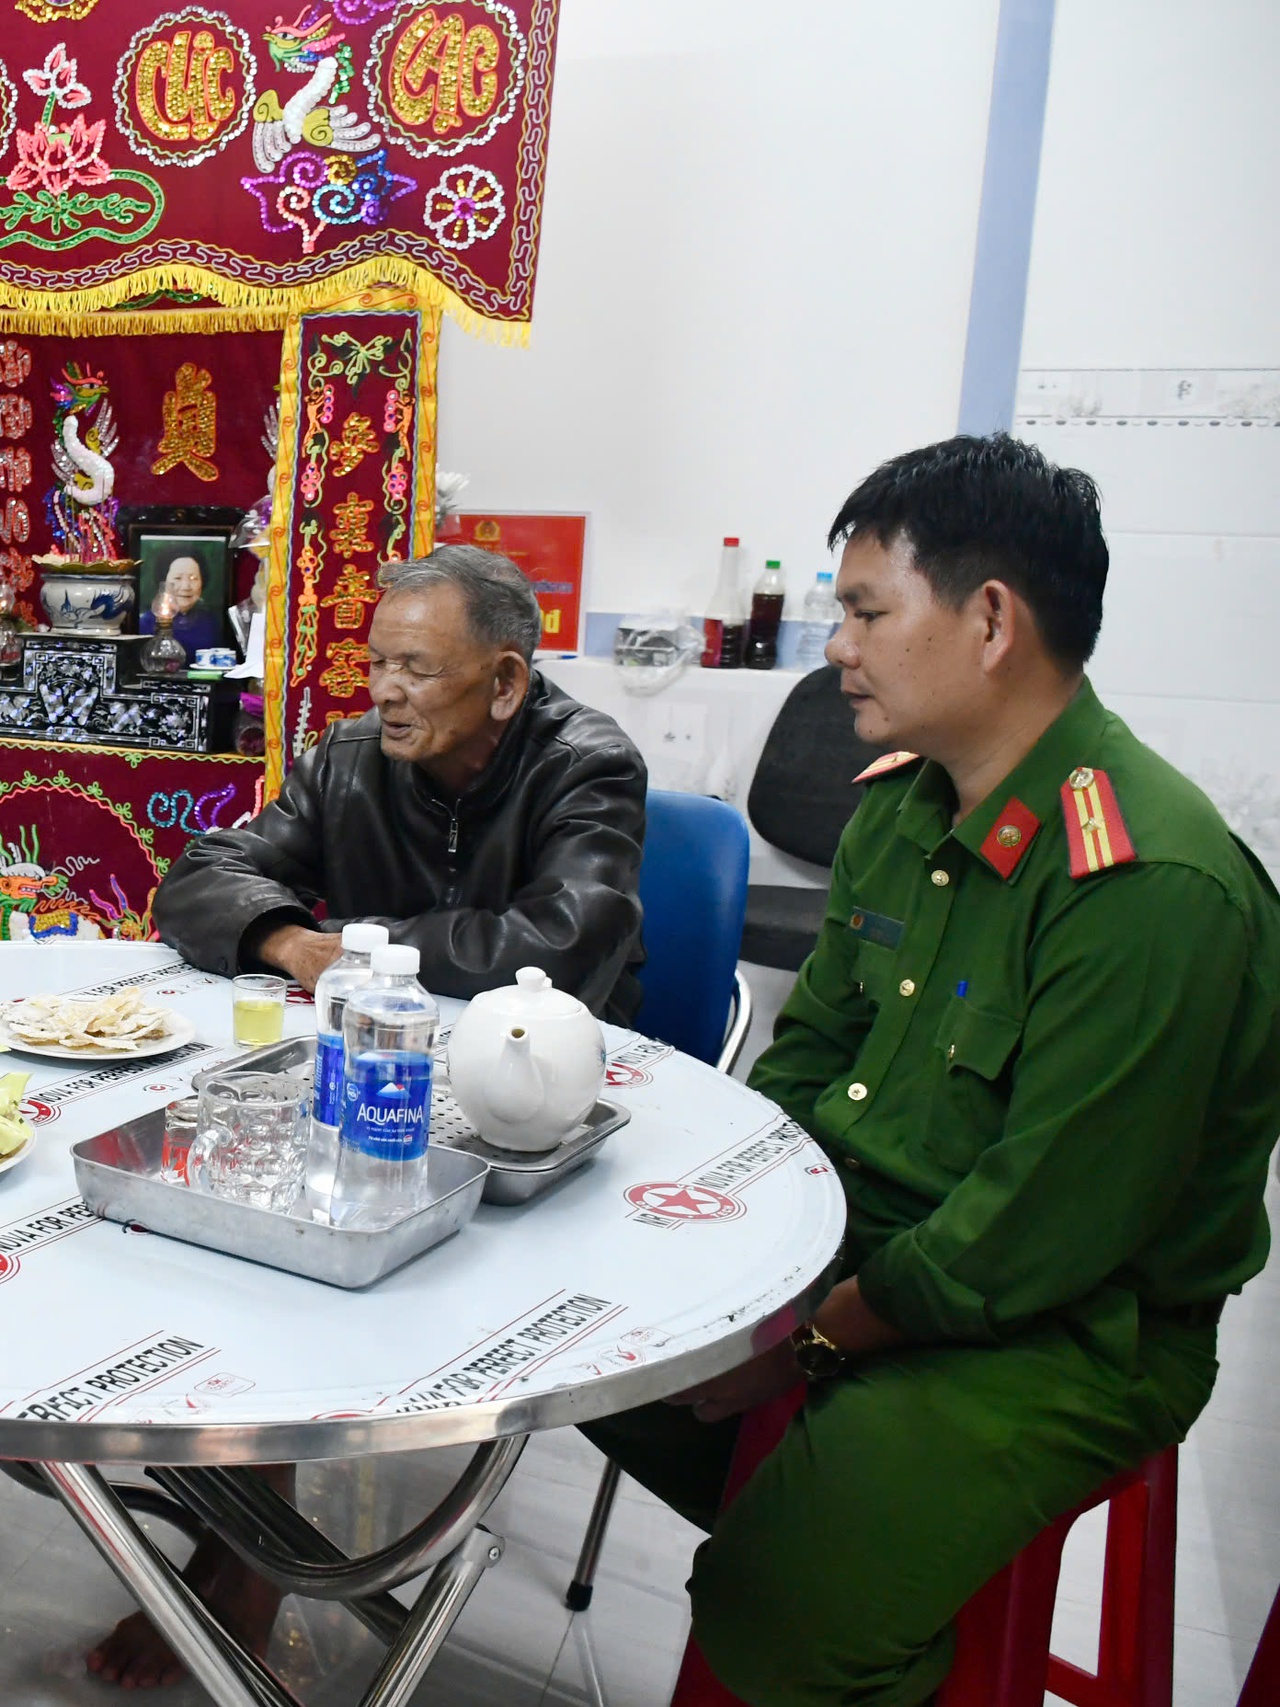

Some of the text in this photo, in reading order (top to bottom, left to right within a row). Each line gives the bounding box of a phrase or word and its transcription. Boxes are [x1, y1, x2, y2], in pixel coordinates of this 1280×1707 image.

[136, 30, 236, 141] CỰC
[389, 9, 500, 135] LẠC
[29, 1088, 74, 1103] NOVA
[65, 1078, 102, 1092] FOR
[357, 1103, 423, 1126] AQUAFINA
[692, 1171, 738, 1190] NOVA
[717, 1160, 756, 1176] FOR
[26, 1216, 74, 1235] FOR
[462, 1338, 542, 1381] PERFECT
[516, 1292, 612, 1346] PROTECTION
[85, 1335, 205, 1393] PROTECTION
